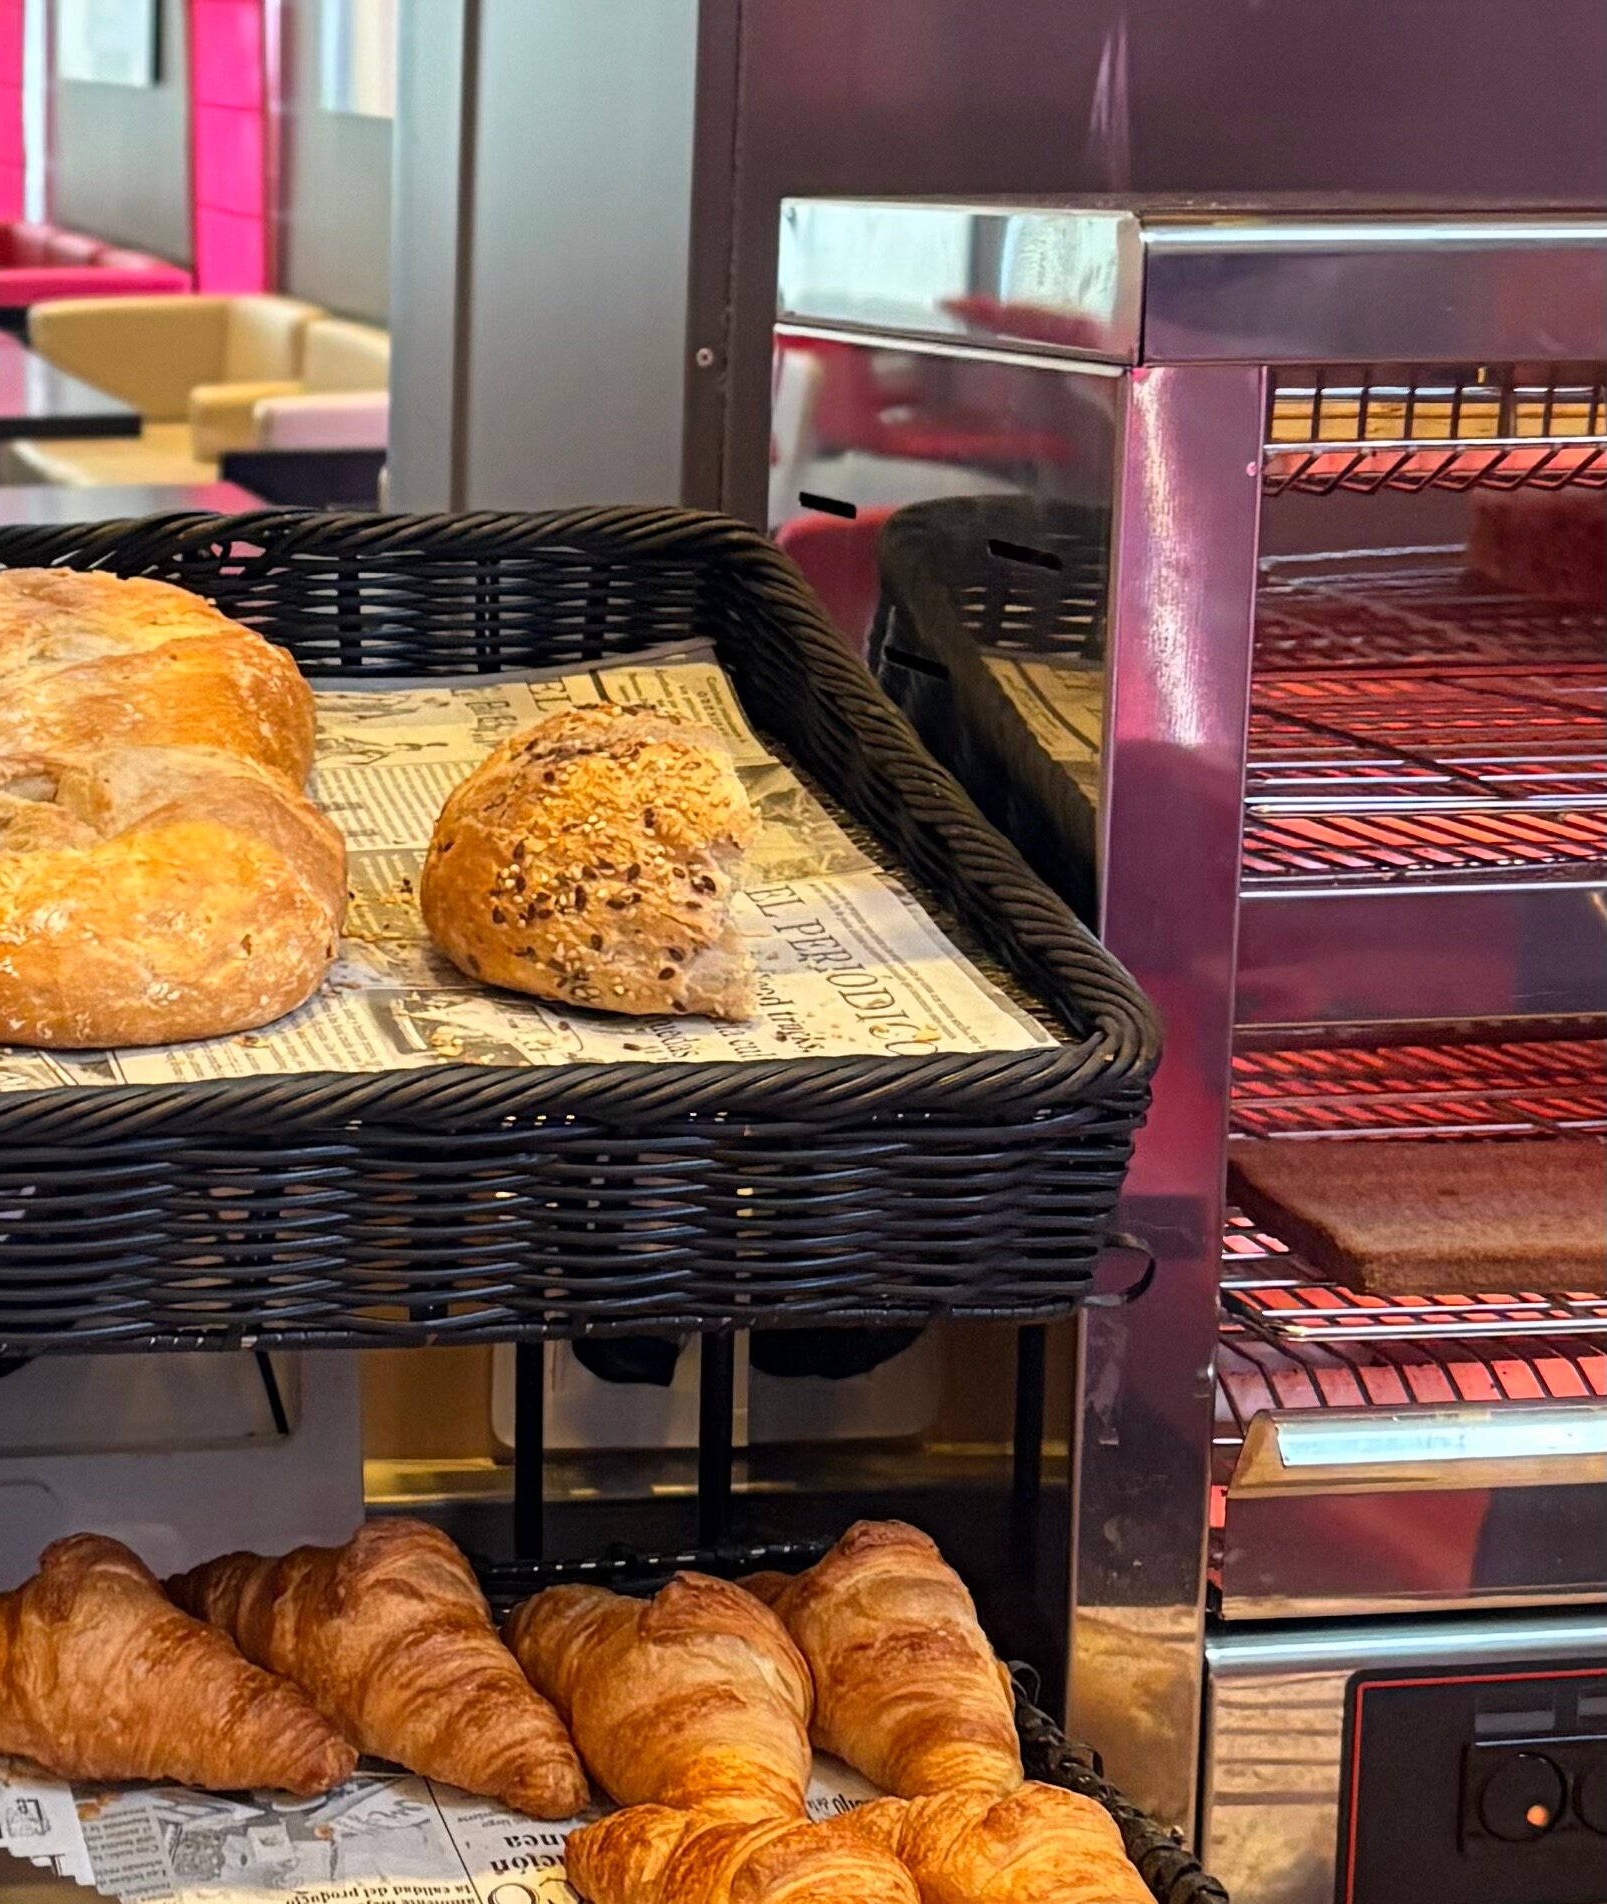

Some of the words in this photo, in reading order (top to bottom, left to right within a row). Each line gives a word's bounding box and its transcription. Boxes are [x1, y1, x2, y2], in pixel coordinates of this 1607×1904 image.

[745, 885, 805, 918] EL
[773, 917, 938, 1055] PERIÓDICO
[363, 1887, 388, 1899] del
[393, 1884, 451, 1895] calidad
[455, 1884, 472, 1895] la
